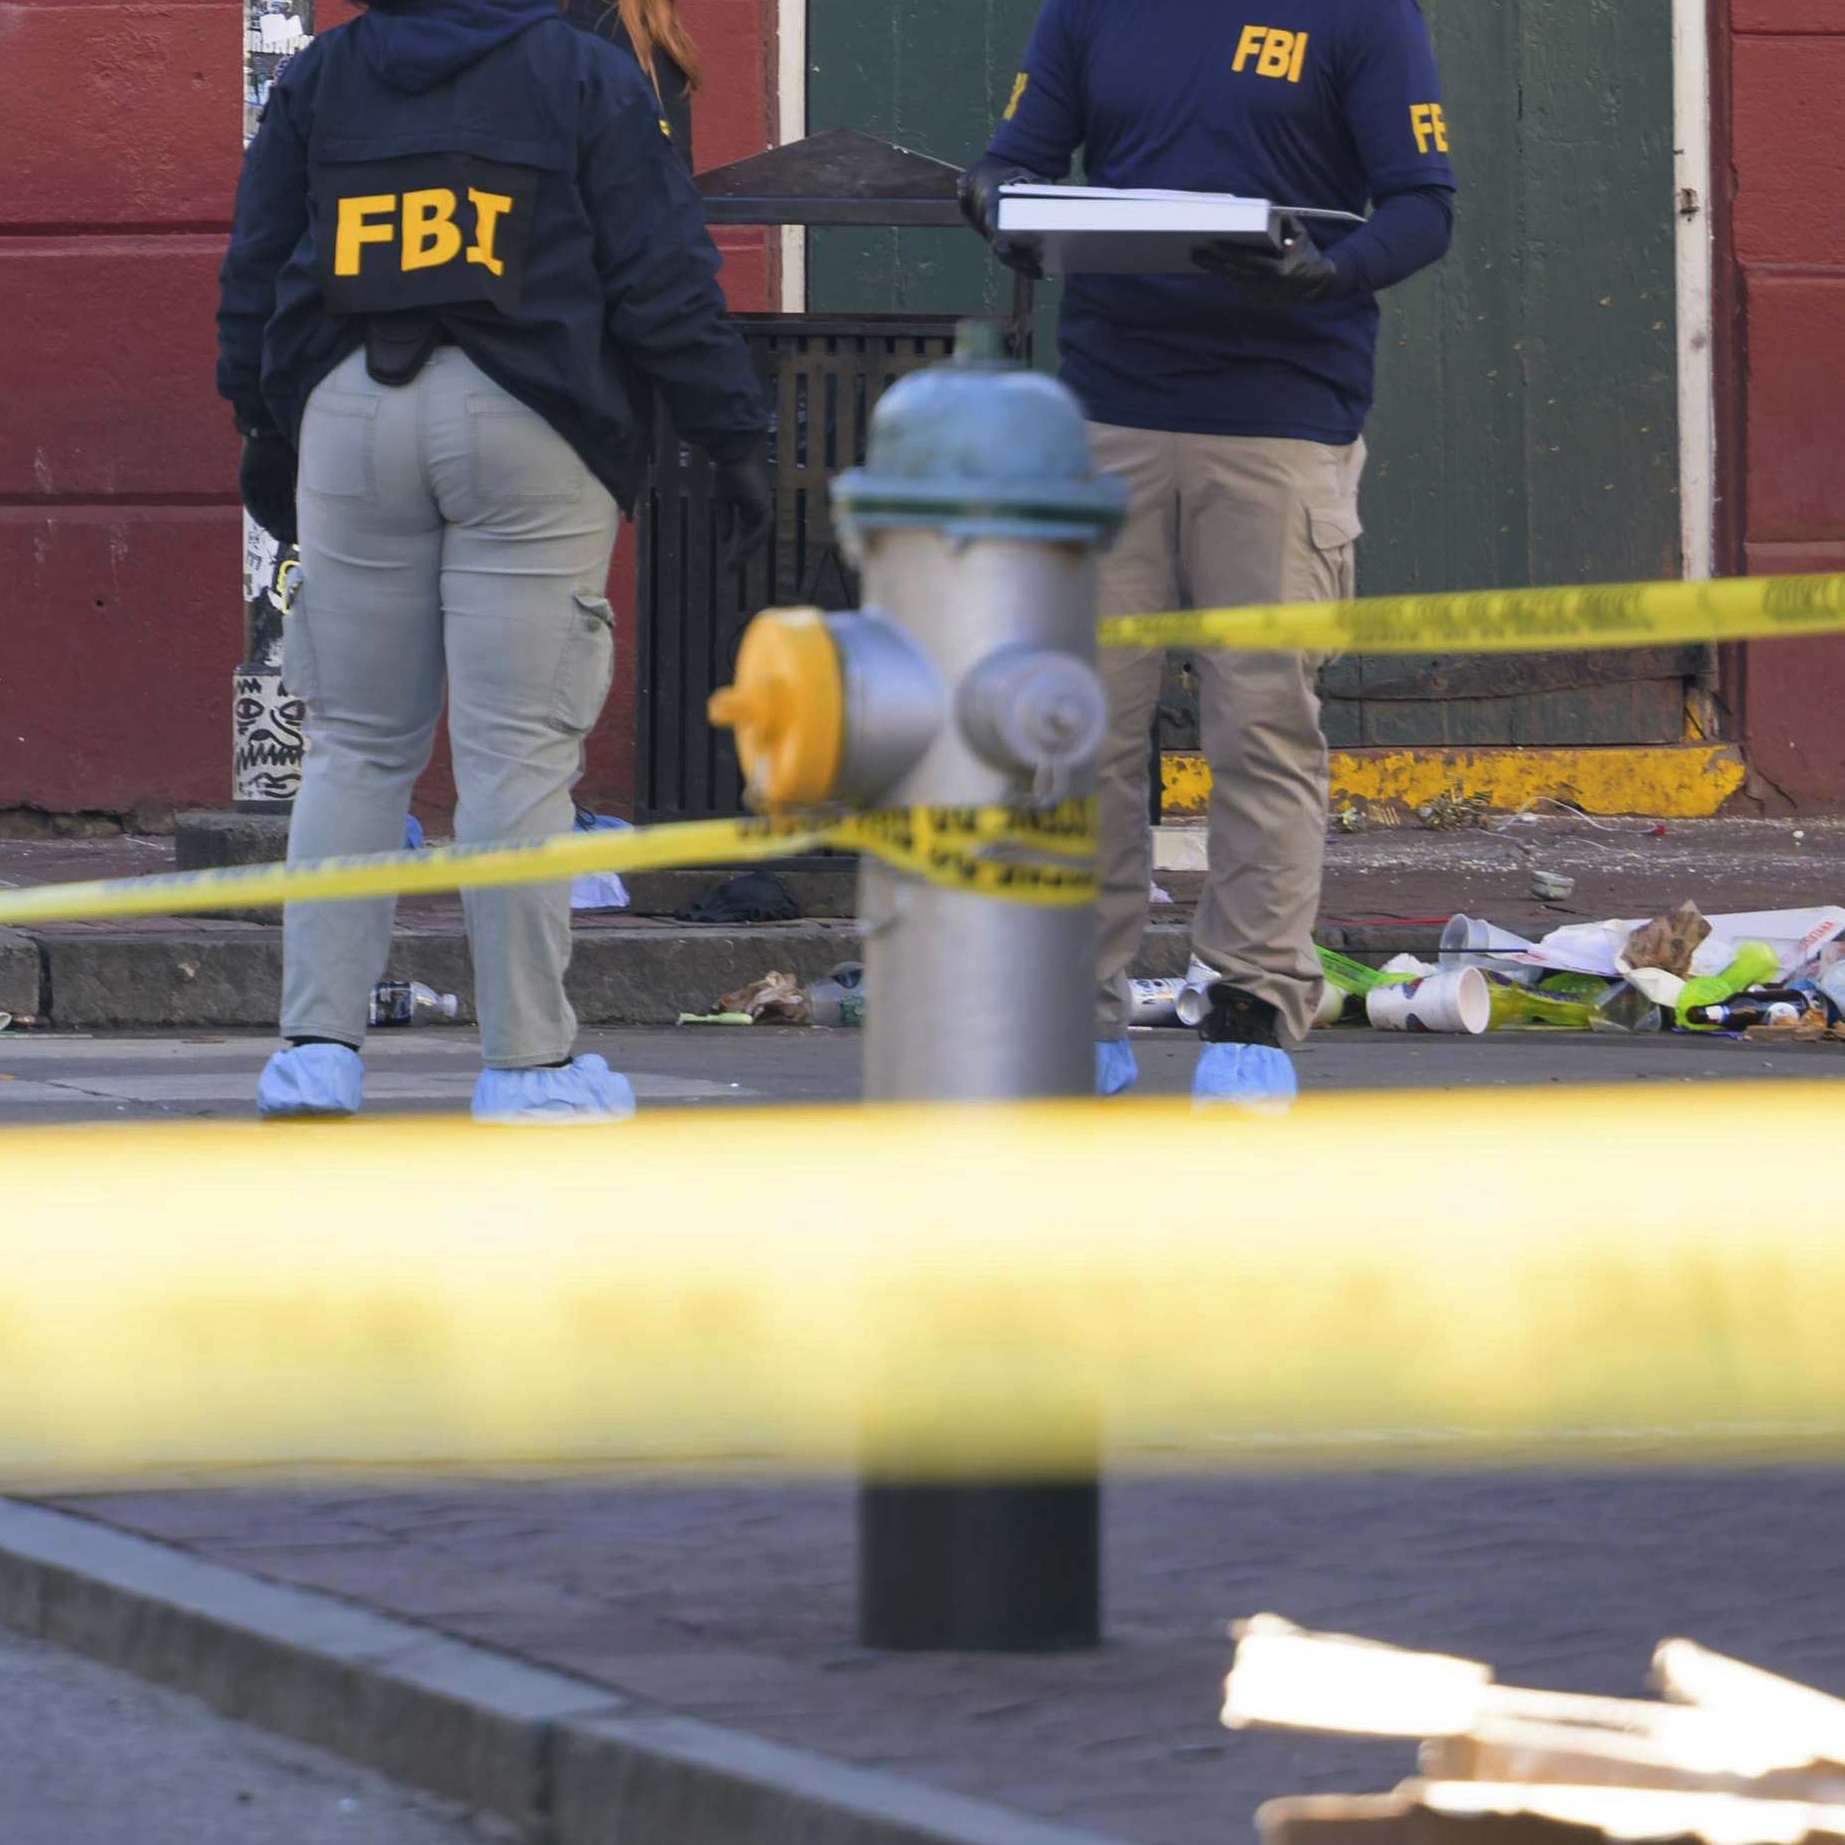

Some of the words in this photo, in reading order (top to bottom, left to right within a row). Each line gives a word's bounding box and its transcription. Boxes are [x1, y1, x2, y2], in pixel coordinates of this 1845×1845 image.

[1231, 24, 1308, 83] FBI
[1409, 102, 1449, 153] FB
[335, 186, 512, 276] FBI
